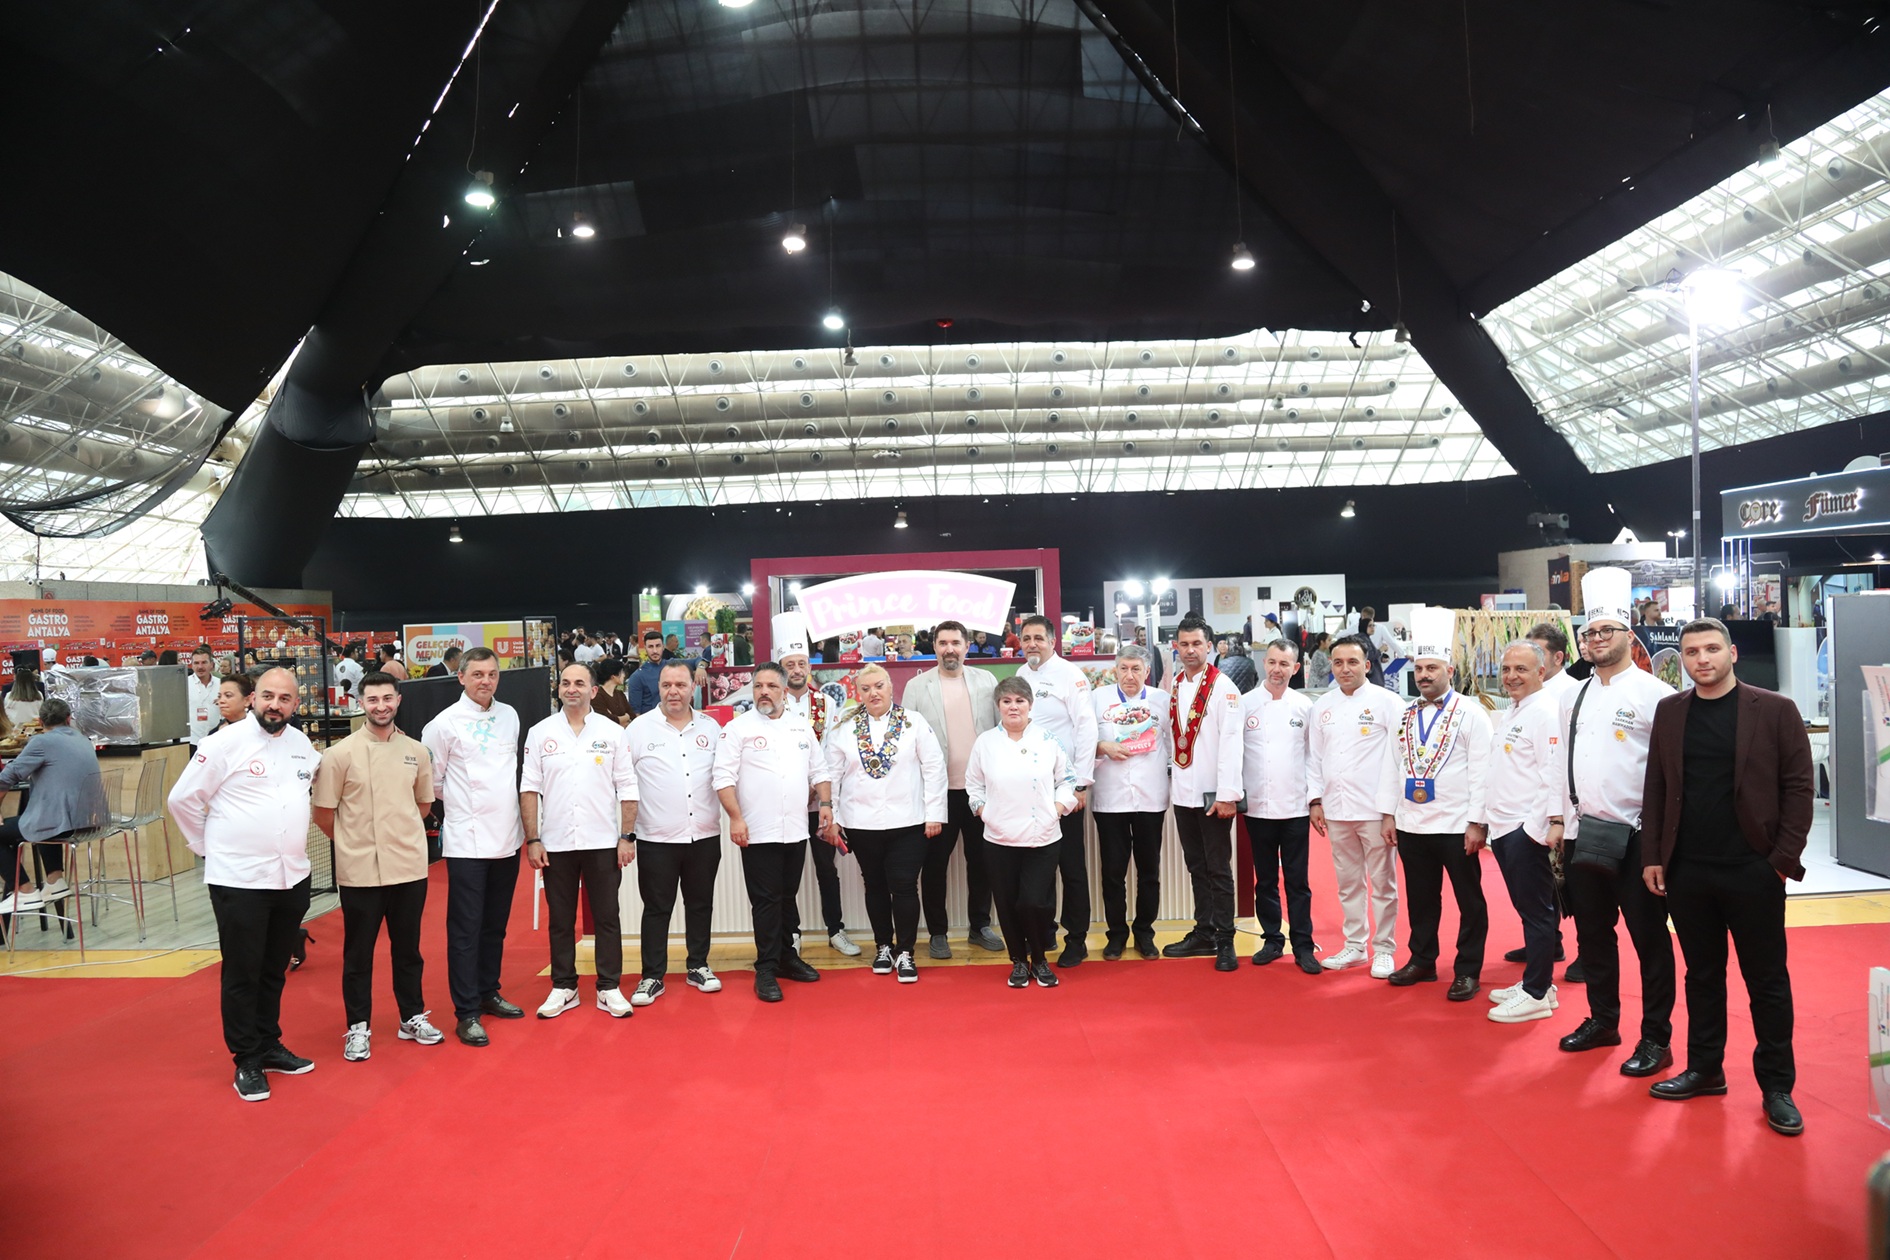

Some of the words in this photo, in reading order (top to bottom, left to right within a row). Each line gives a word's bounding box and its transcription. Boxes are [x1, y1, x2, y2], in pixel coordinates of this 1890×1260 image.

[811, 593, 919, 629] Prince
[927, 583, 996, 620] Food
[28, 614, 68, 625] GASTRO
[136, 614, 169, 625] GASTRO
[27, 626, 71, 637] ANTALYA
[136, 625, 170, 635] ANTALYA
